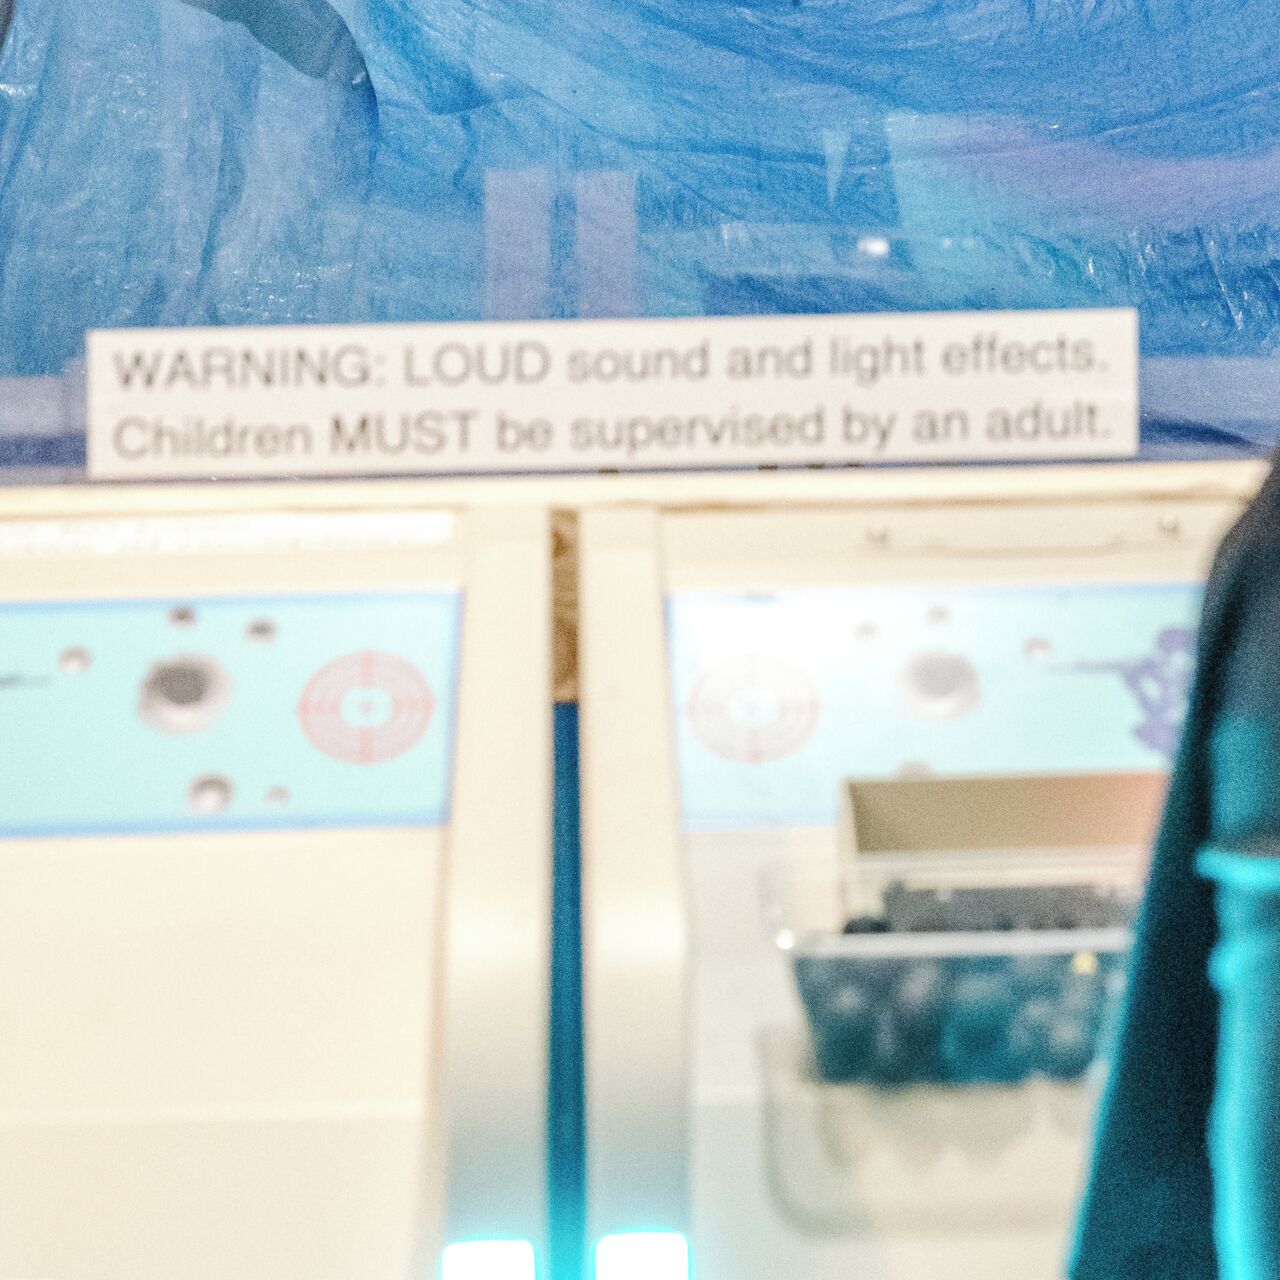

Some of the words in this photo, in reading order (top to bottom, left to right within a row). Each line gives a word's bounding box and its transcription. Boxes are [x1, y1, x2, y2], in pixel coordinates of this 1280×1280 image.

[113, 342, 385, 391] WARNING:
[402, 339, 551, 386] LOUD
[566, 338, 709, 384] sound
[726, 335, 813, 381] and
[830, 335, 925, 387] light
[941, 332, 1108, 376] effects.
[113, 413, 312, 459] Children
[329, 408, 477, 456] MUST
[495, 410, 553, 454] be
[569, 404, 825, 457] supervised
[842, 403, 898, 453] by
[913, 408, 968, 442] an
[985, 400, 1111, 441] adult.
